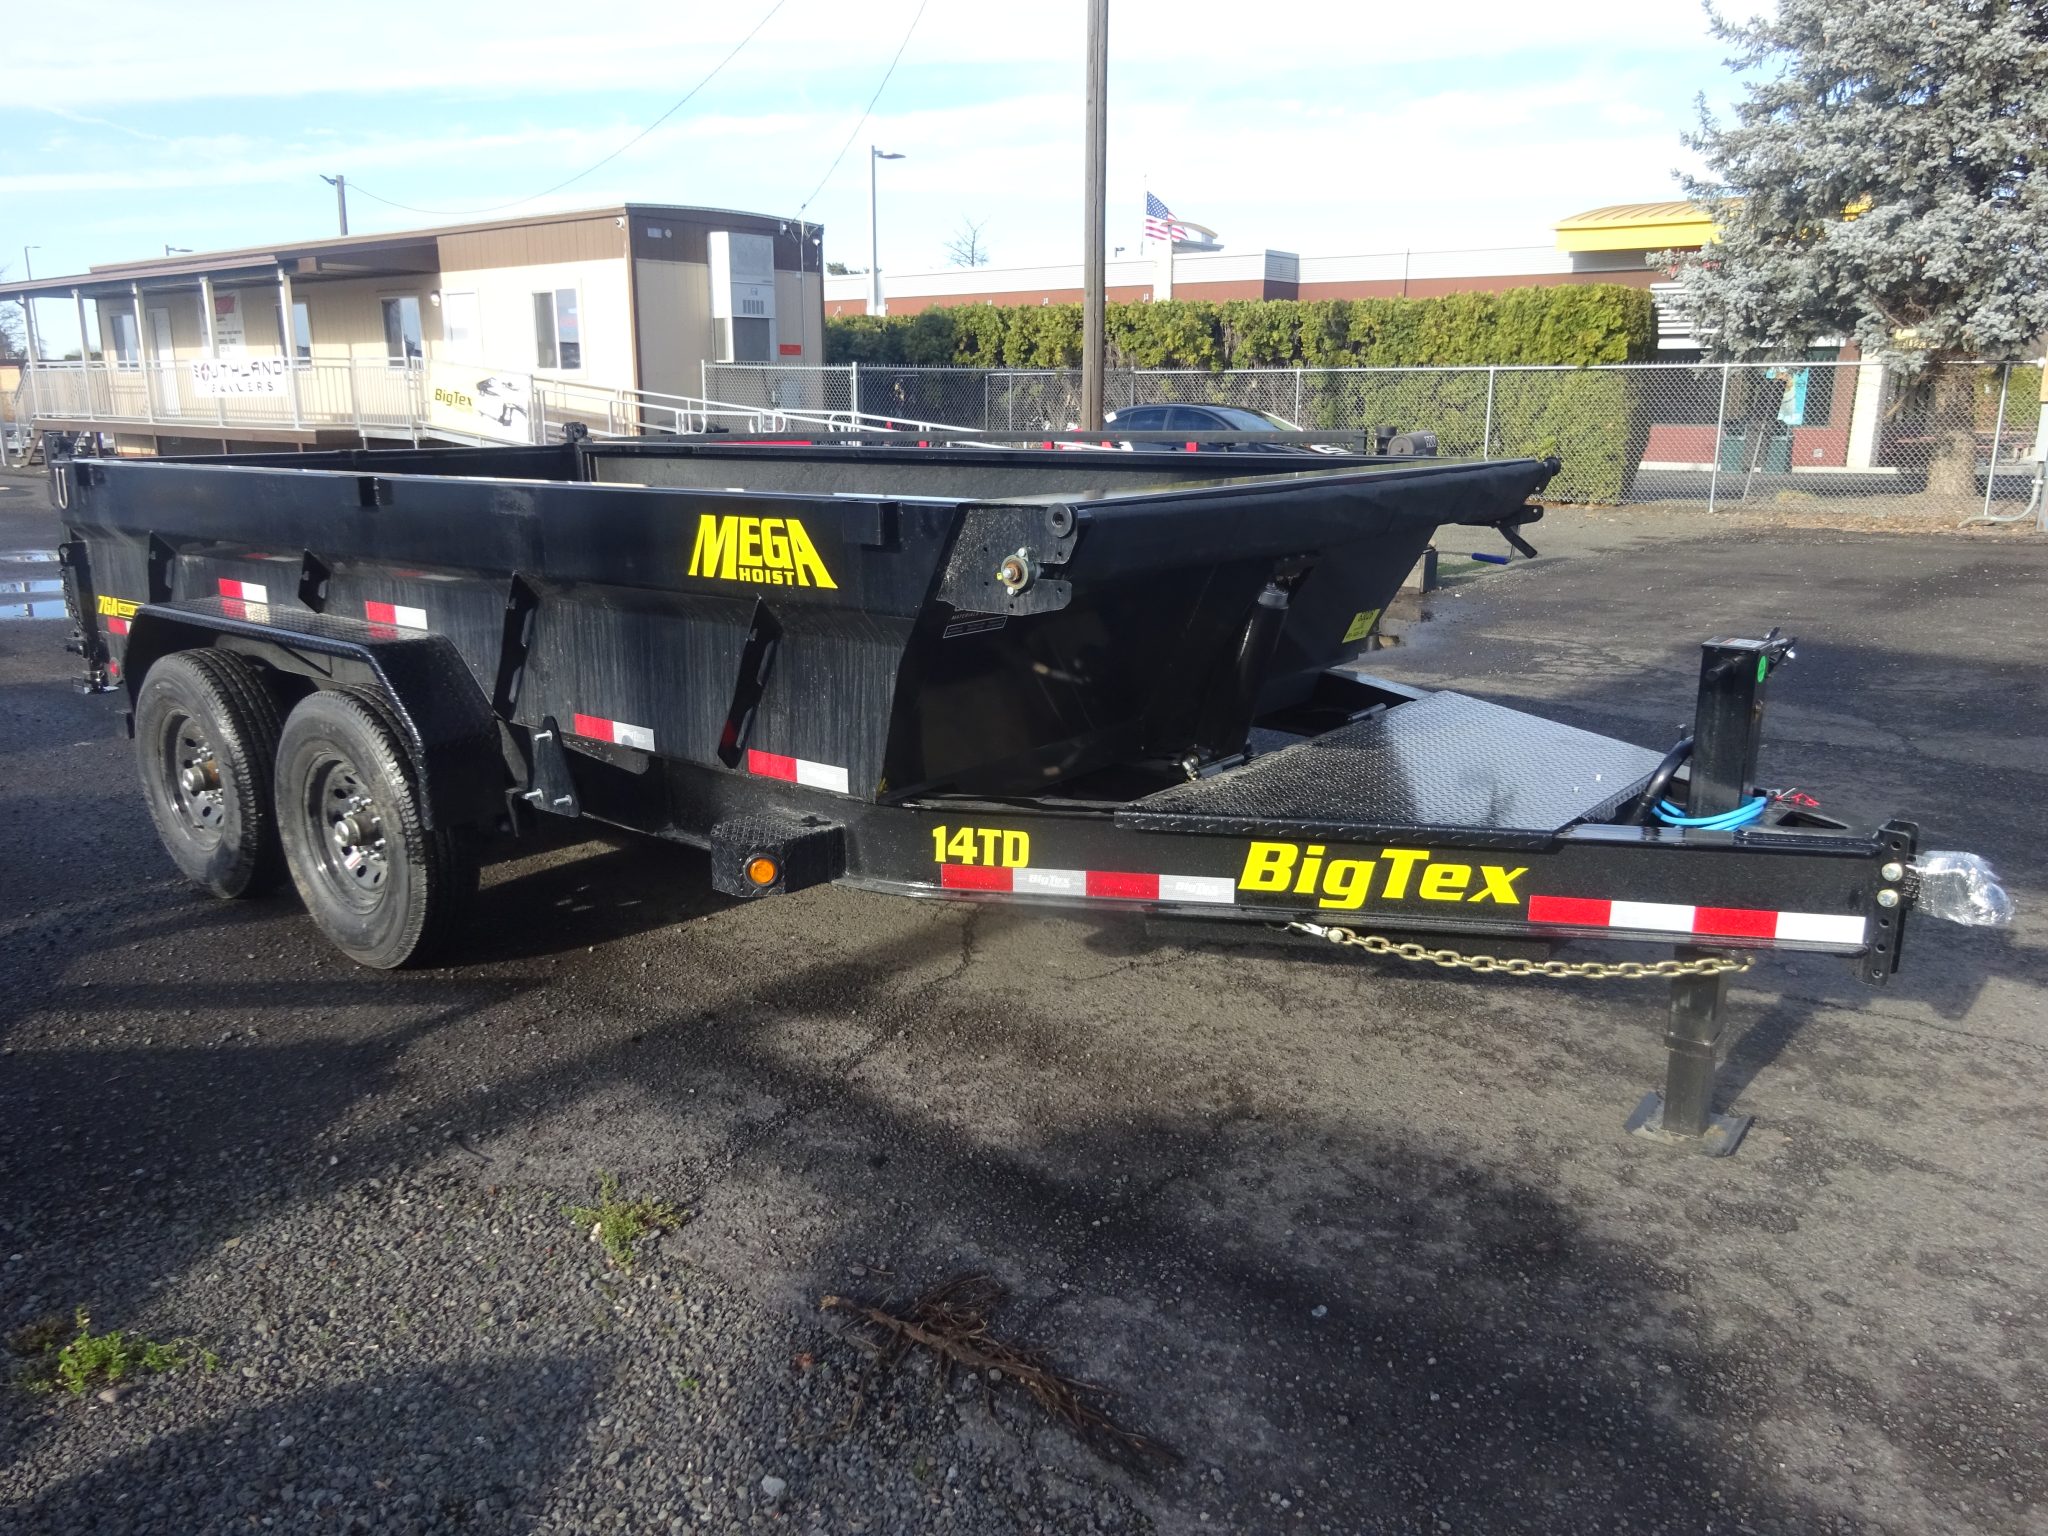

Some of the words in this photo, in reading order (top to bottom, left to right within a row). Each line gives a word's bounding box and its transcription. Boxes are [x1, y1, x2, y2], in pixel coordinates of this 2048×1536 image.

[203, 381, 274, 393] RAILERS
[434, 388, 473, 407] BigTex
[688, 514, 839, 589] MEGA
[738, 567, 795, 586] HOIST
[932, 825, 1030, 868] 14TD
[1237, 841, 1529, 910] BigTex
